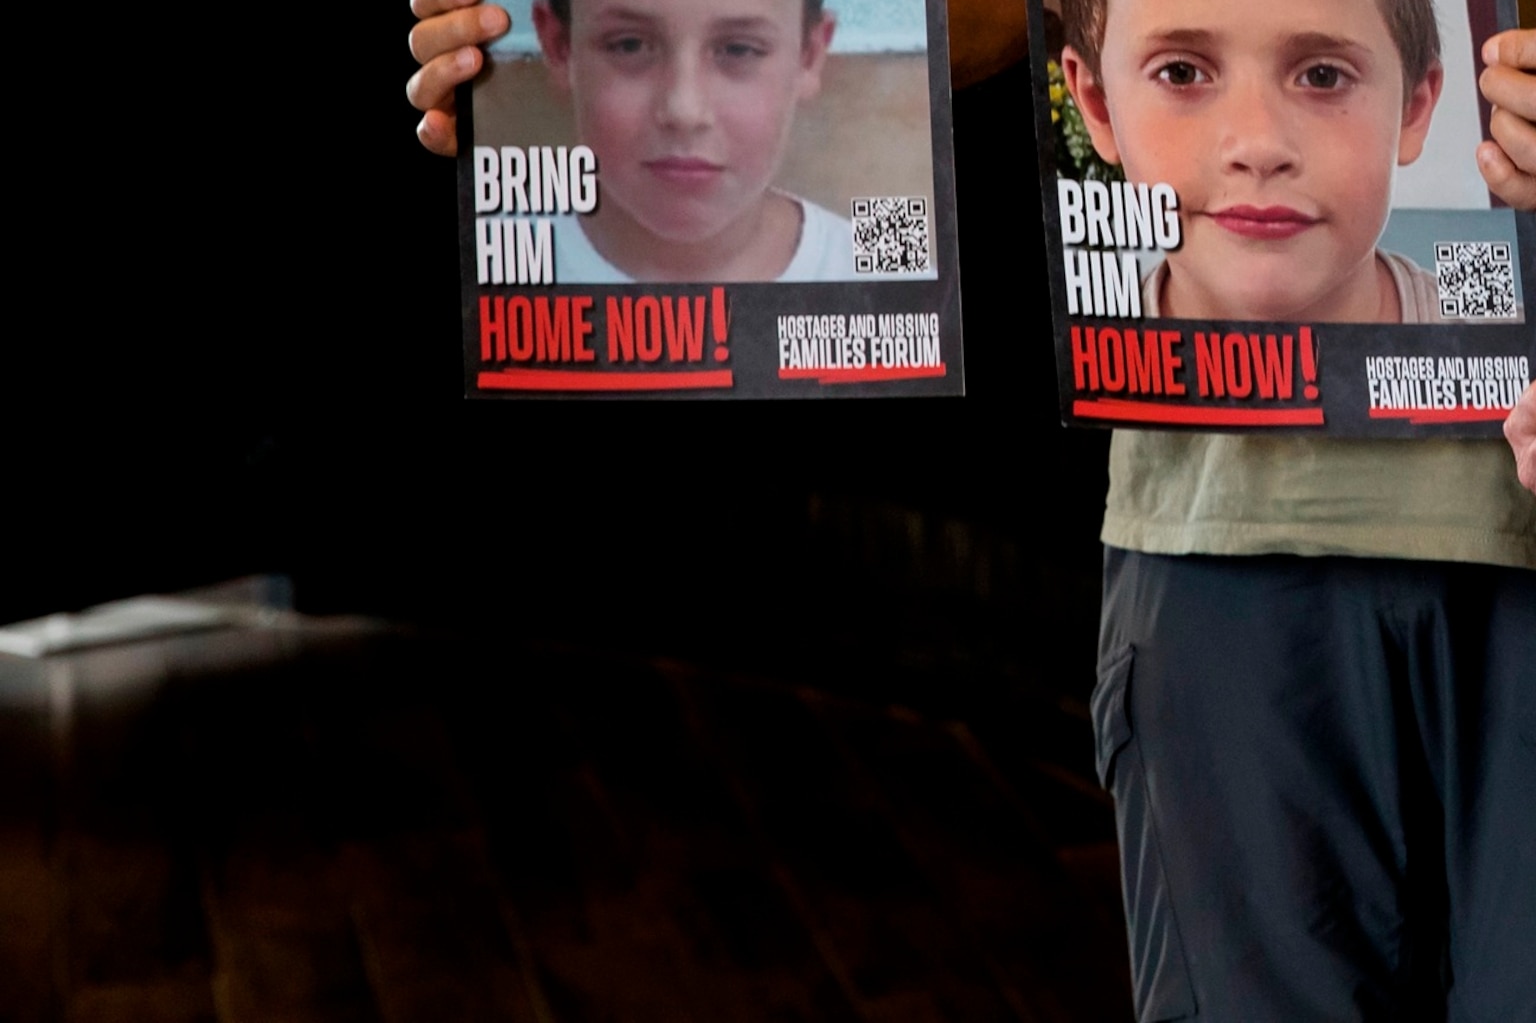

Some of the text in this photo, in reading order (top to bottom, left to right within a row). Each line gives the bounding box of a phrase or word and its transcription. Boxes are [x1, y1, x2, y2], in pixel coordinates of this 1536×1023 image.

[473, 145, 597, 214] BRING
[1057, 179, 1180, 249] BRING
[476, 218, 555, 285] HIM
[1062, 249, 1142, 318] HIM
[478, 286, 731, 363] HOME NOW!
[777, 313, 939, 339] HOSTAGES AND MISSING
[778, 337, 941, 370] FAMILIES FORUM
[1070, 326, 1320, 400] HOME NOW!
[1366, 356, 1528, 380] HOSTAGES AND MISSING
[1368, 379, 1456, 410] FAMILIES
